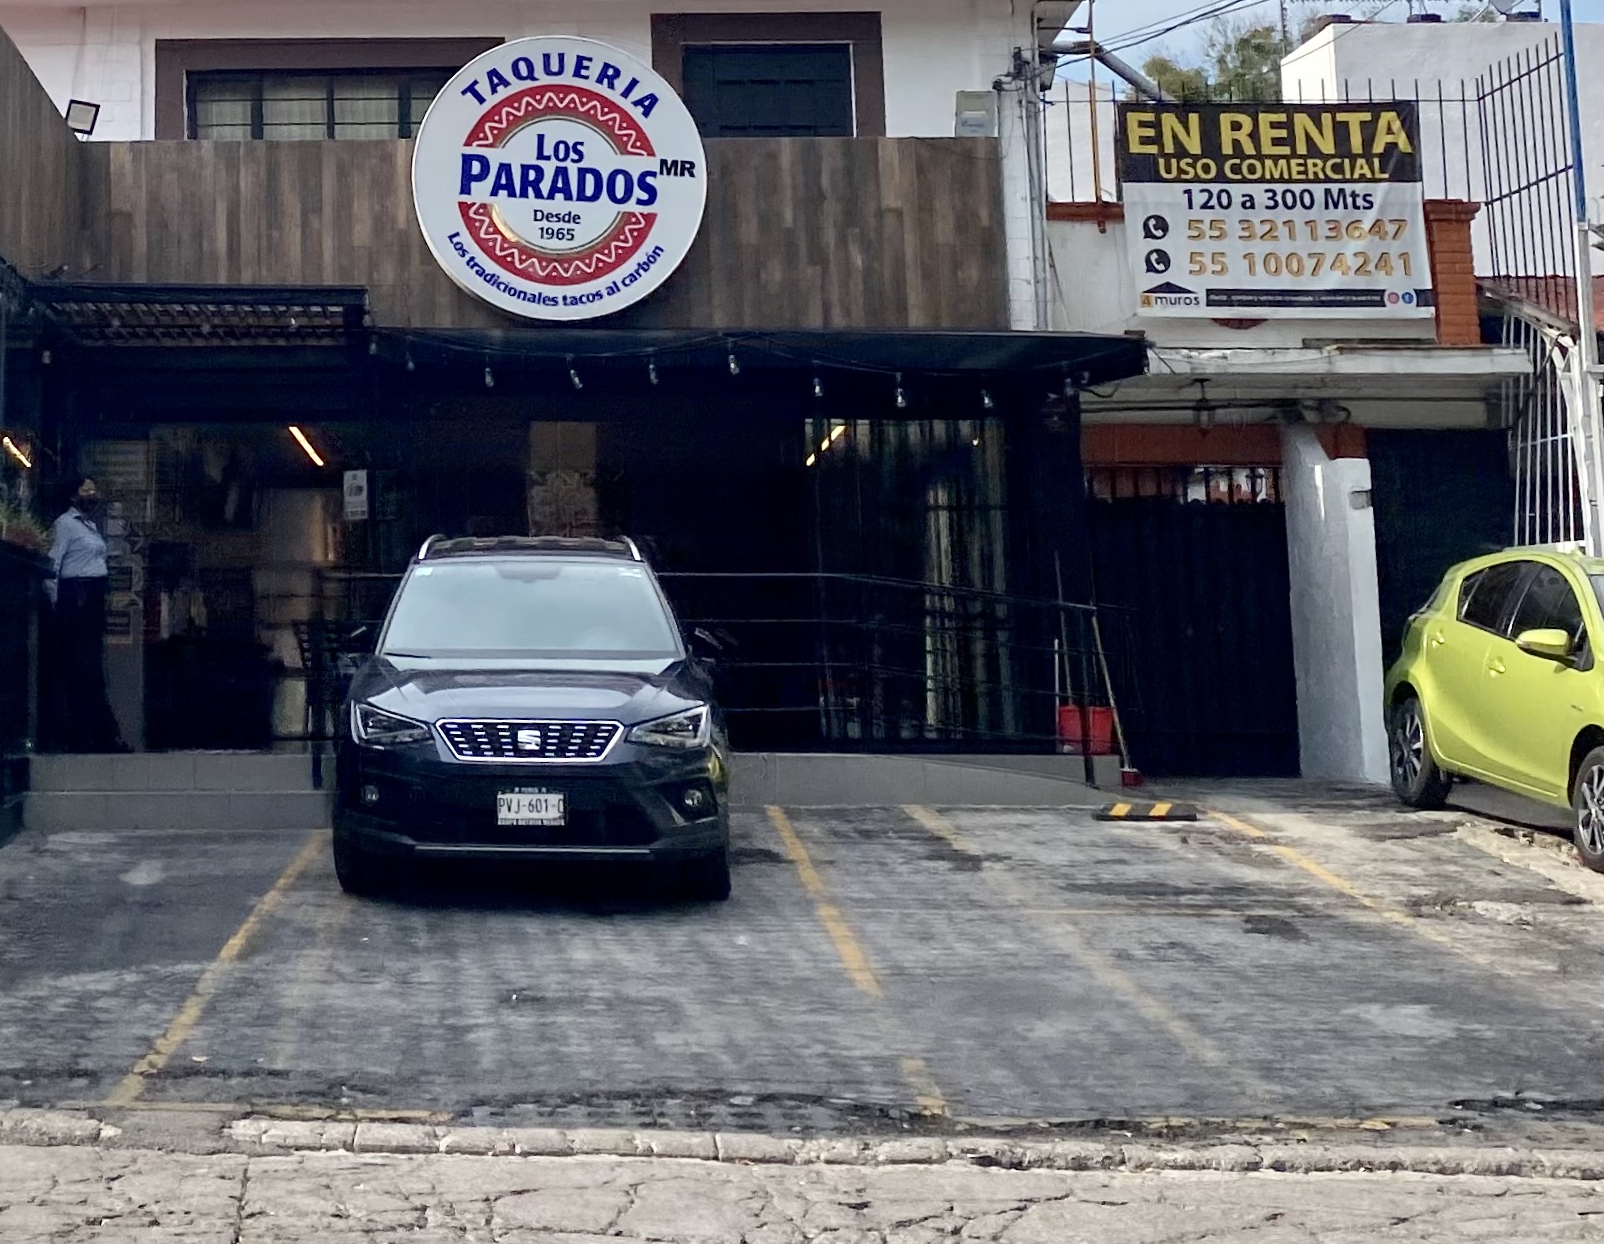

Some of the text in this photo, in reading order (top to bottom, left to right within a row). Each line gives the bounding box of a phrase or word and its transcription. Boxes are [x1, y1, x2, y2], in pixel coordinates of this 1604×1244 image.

[460, 52, 660, 118] TAQUERIA
[1126, 111, 1413, 155] EN RENTA
[459, 153, 659, 207] PARADOS
[659, 159, 696, 178] MR
[1158, 157, 1389, 180] USO COMERCIAL
[1183, 188, 1374, 211] 120 a 300 Mts
[533, 209, 581, 225] Desde
[538, 227, 575, 241] 1965
[1187, 219, 1409, 242] 55 32113647
[448, 231, 664, 306] Los tradicionales tacos al carbón
[1189, 251, 1413, 277] 55 10074241
